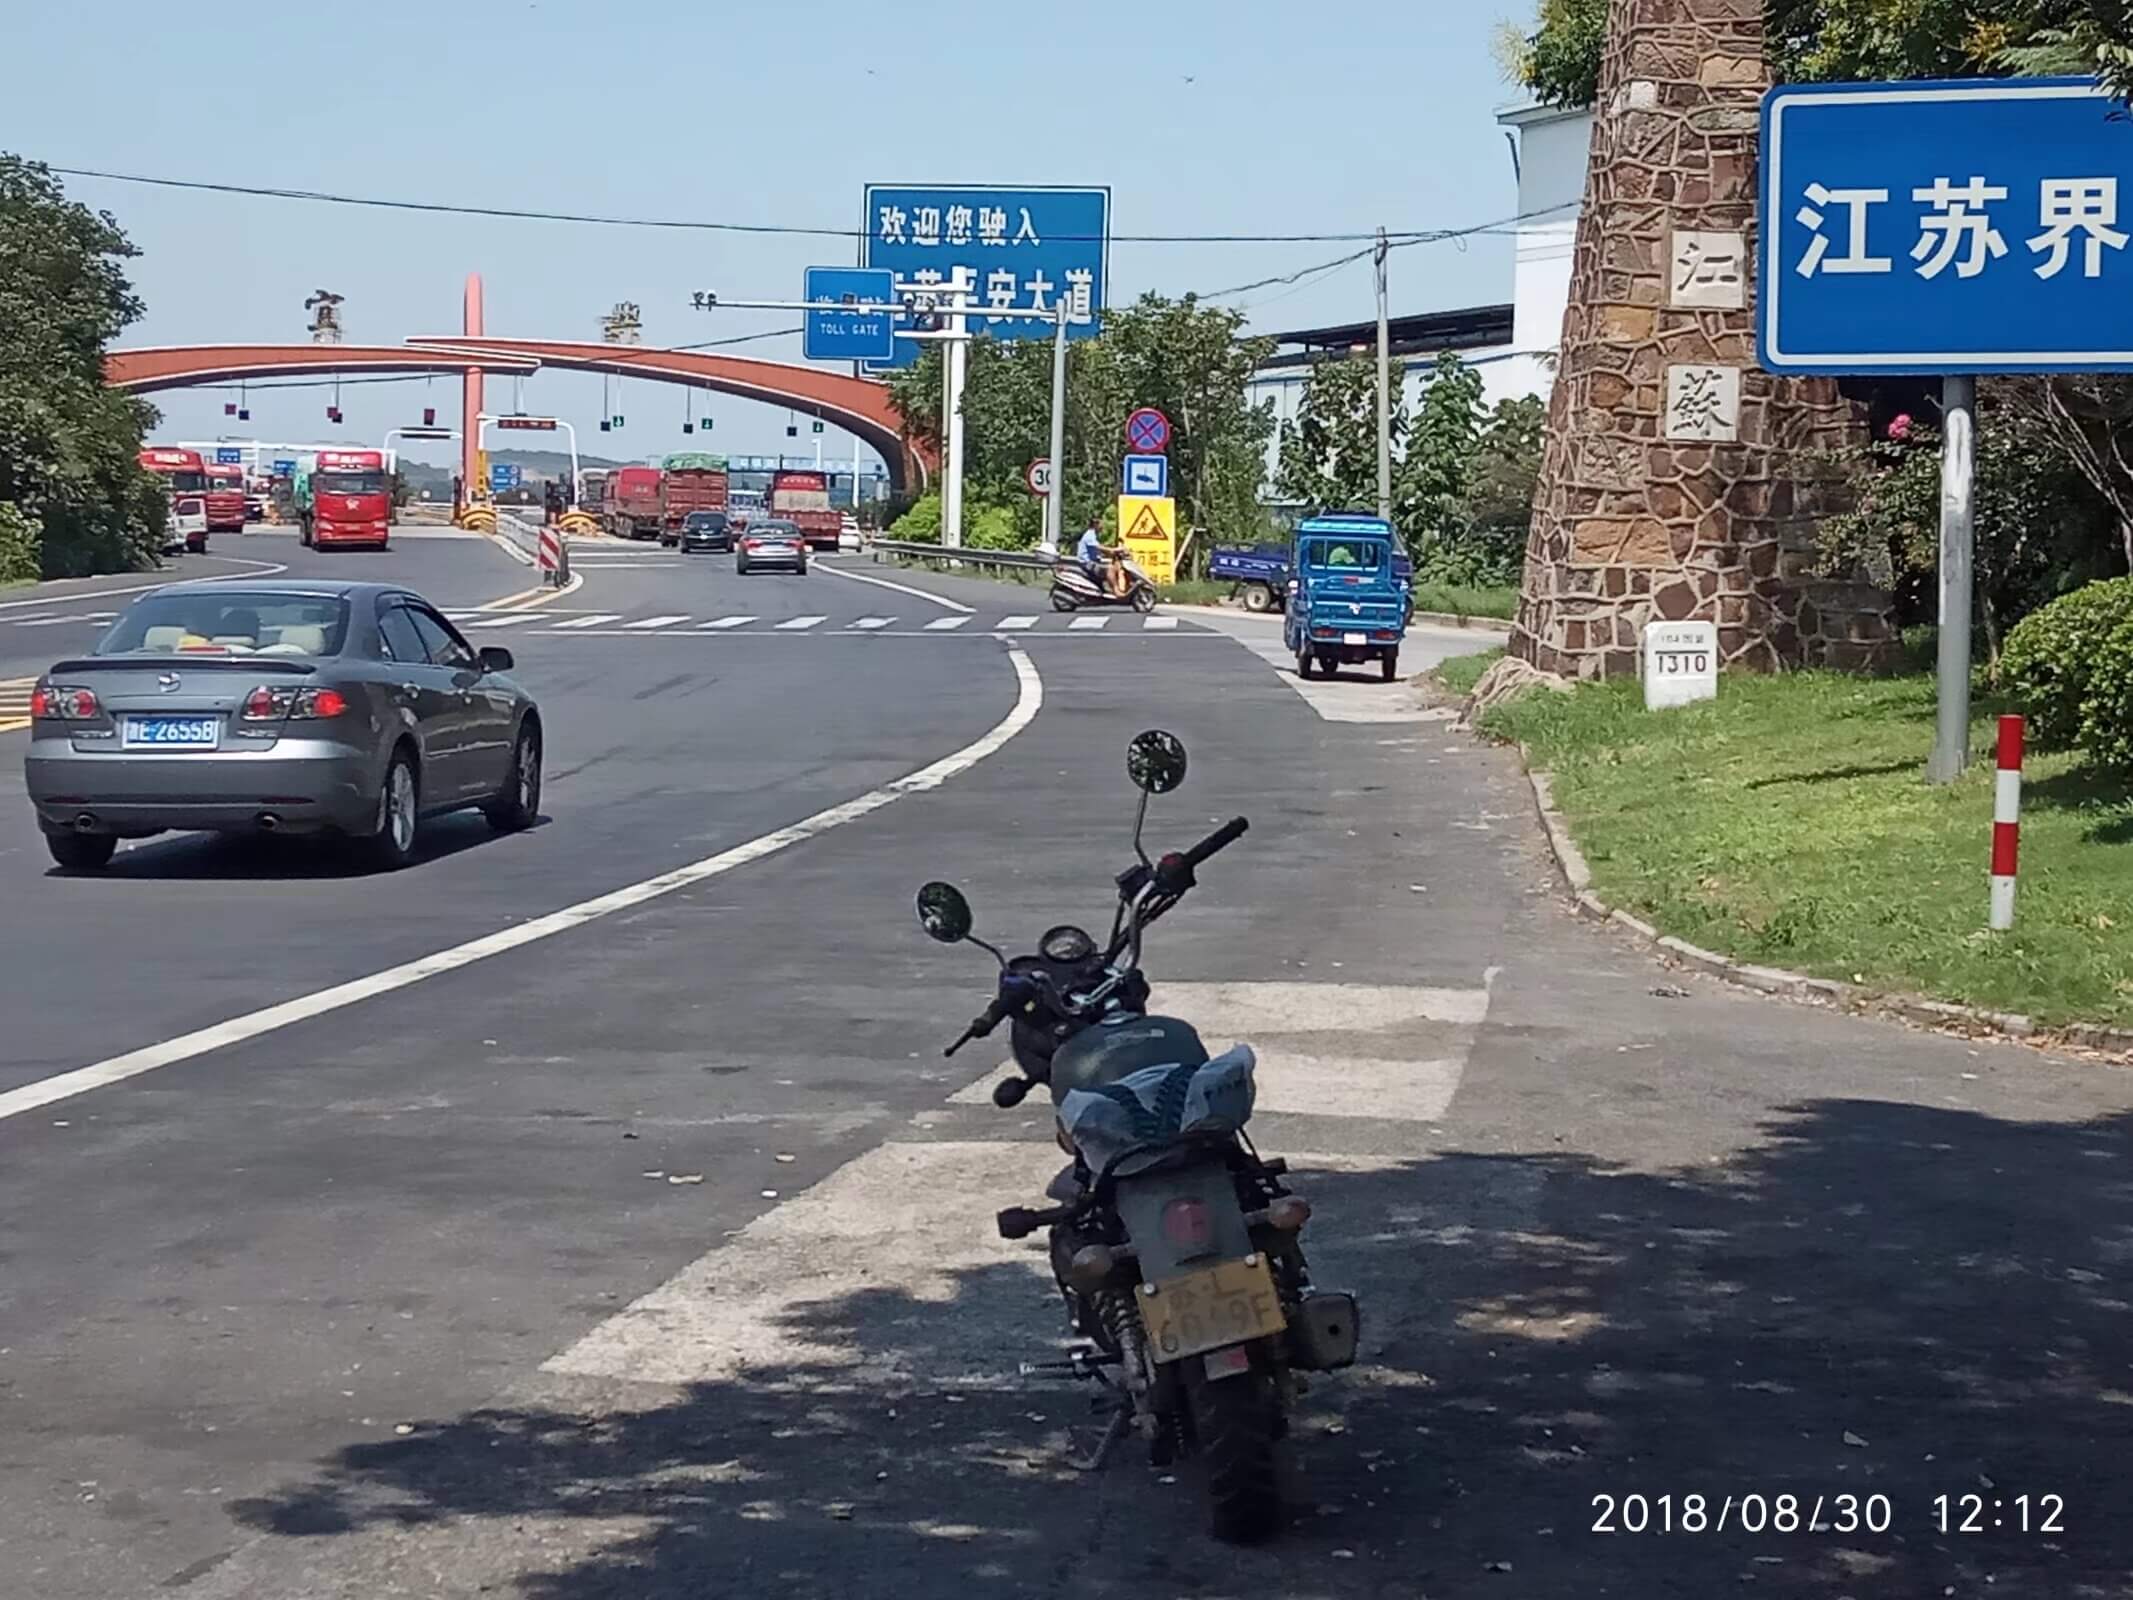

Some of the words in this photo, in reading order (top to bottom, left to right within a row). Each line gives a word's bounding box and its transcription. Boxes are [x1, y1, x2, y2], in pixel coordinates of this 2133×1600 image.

[880, 205, 1040, 246] 欢迎您驶入
[1795, 177, 2130, 280] 江苏界
[820, 324, 846, 335] TOLL
[852, 324, 878, 336] GATE
[1658, 655, 1706, 673] 1310
